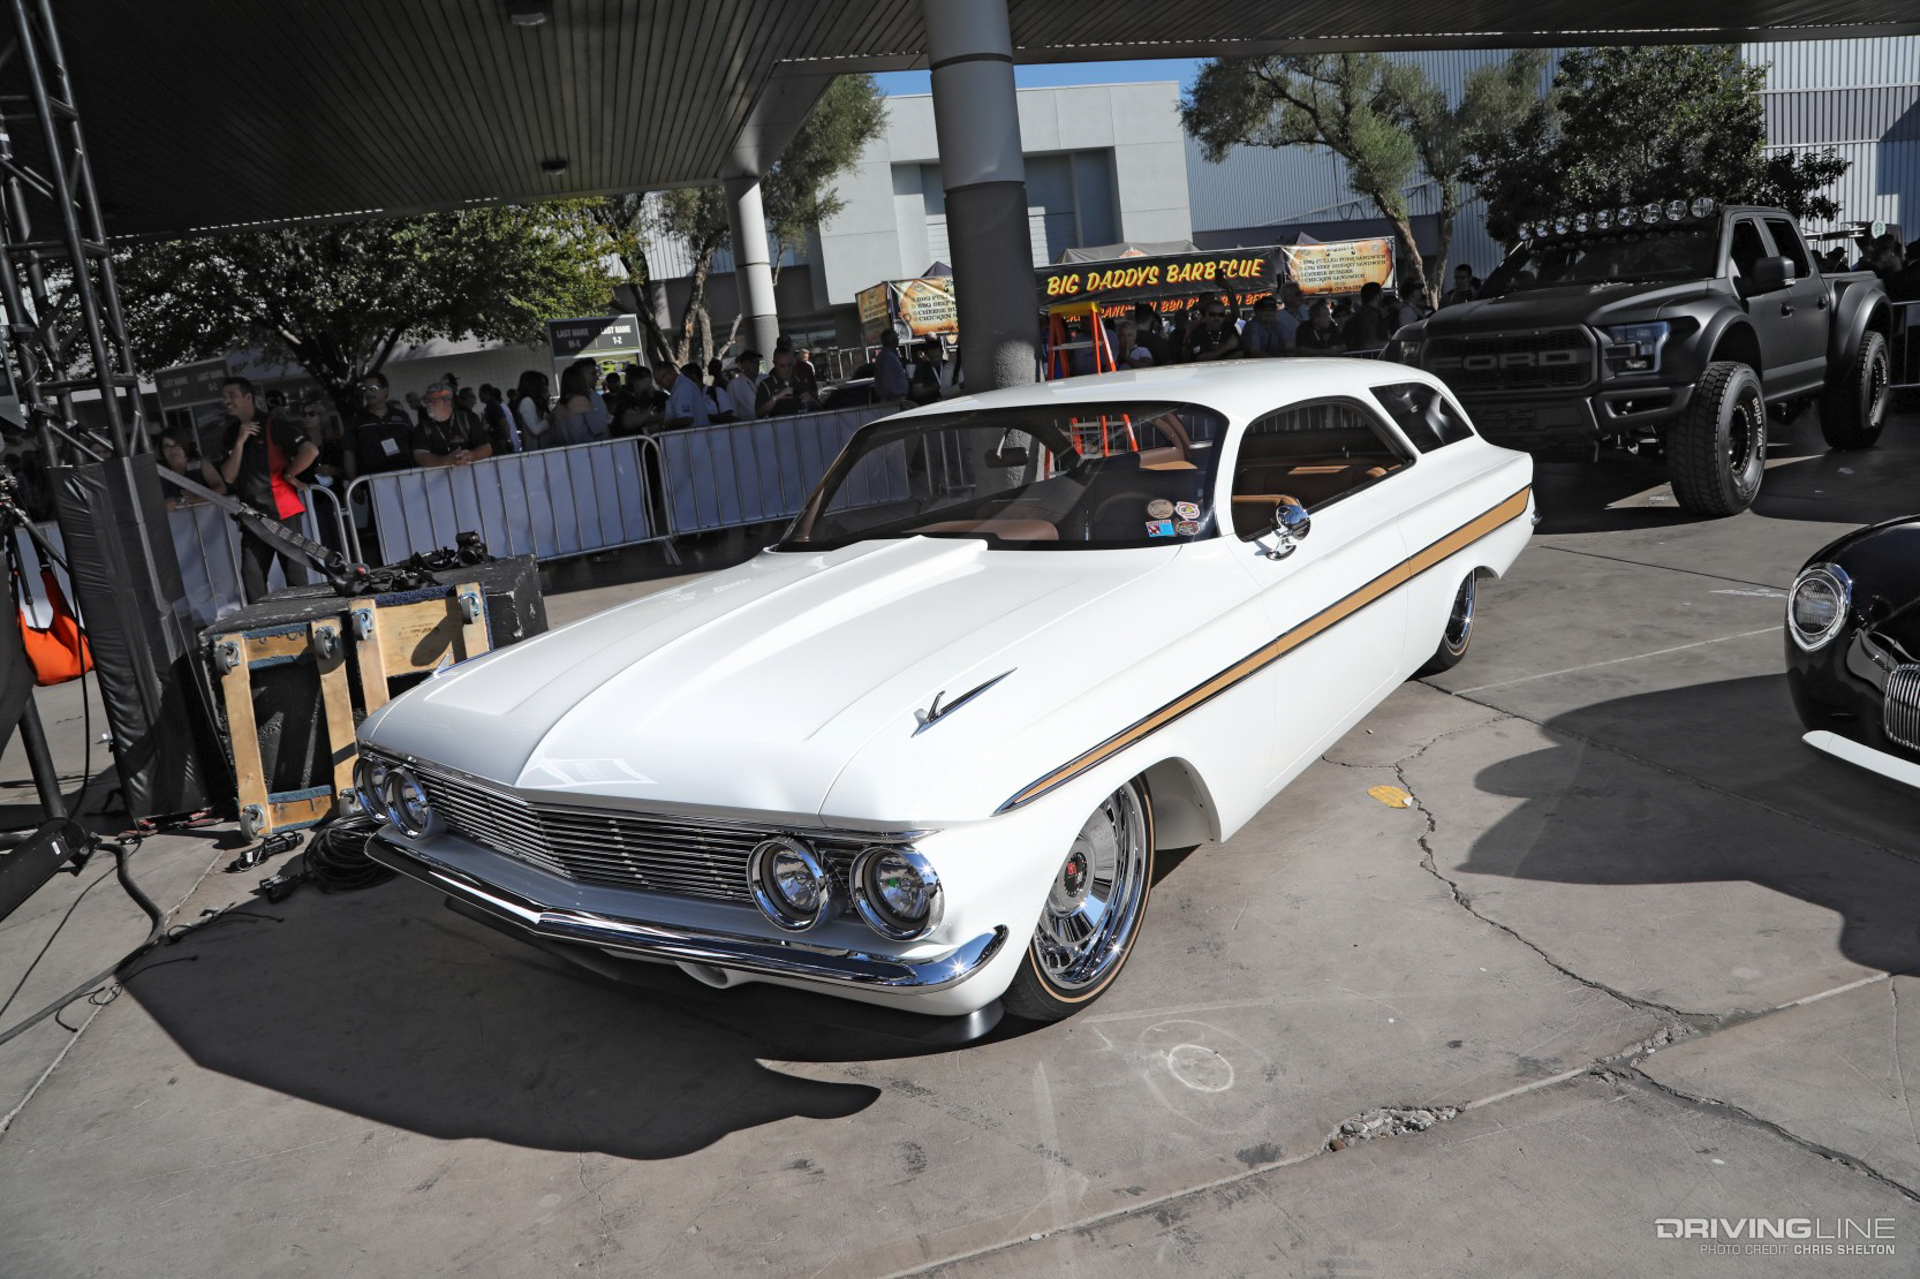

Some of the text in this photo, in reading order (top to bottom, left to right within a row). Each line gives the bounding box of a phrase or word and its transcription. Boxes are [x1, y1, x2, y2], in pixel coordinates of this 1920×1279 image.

[1047, 275, 1080, 296] BIG
[1086, 265, 1160, 292] DADDYS
[556, 327, 590, 338] LAST NAME
[601, 325, 631, 335] LAST NAME
[612, 336, 622, 344] T-Z
[1431, 349, 1578, 371] FORD
